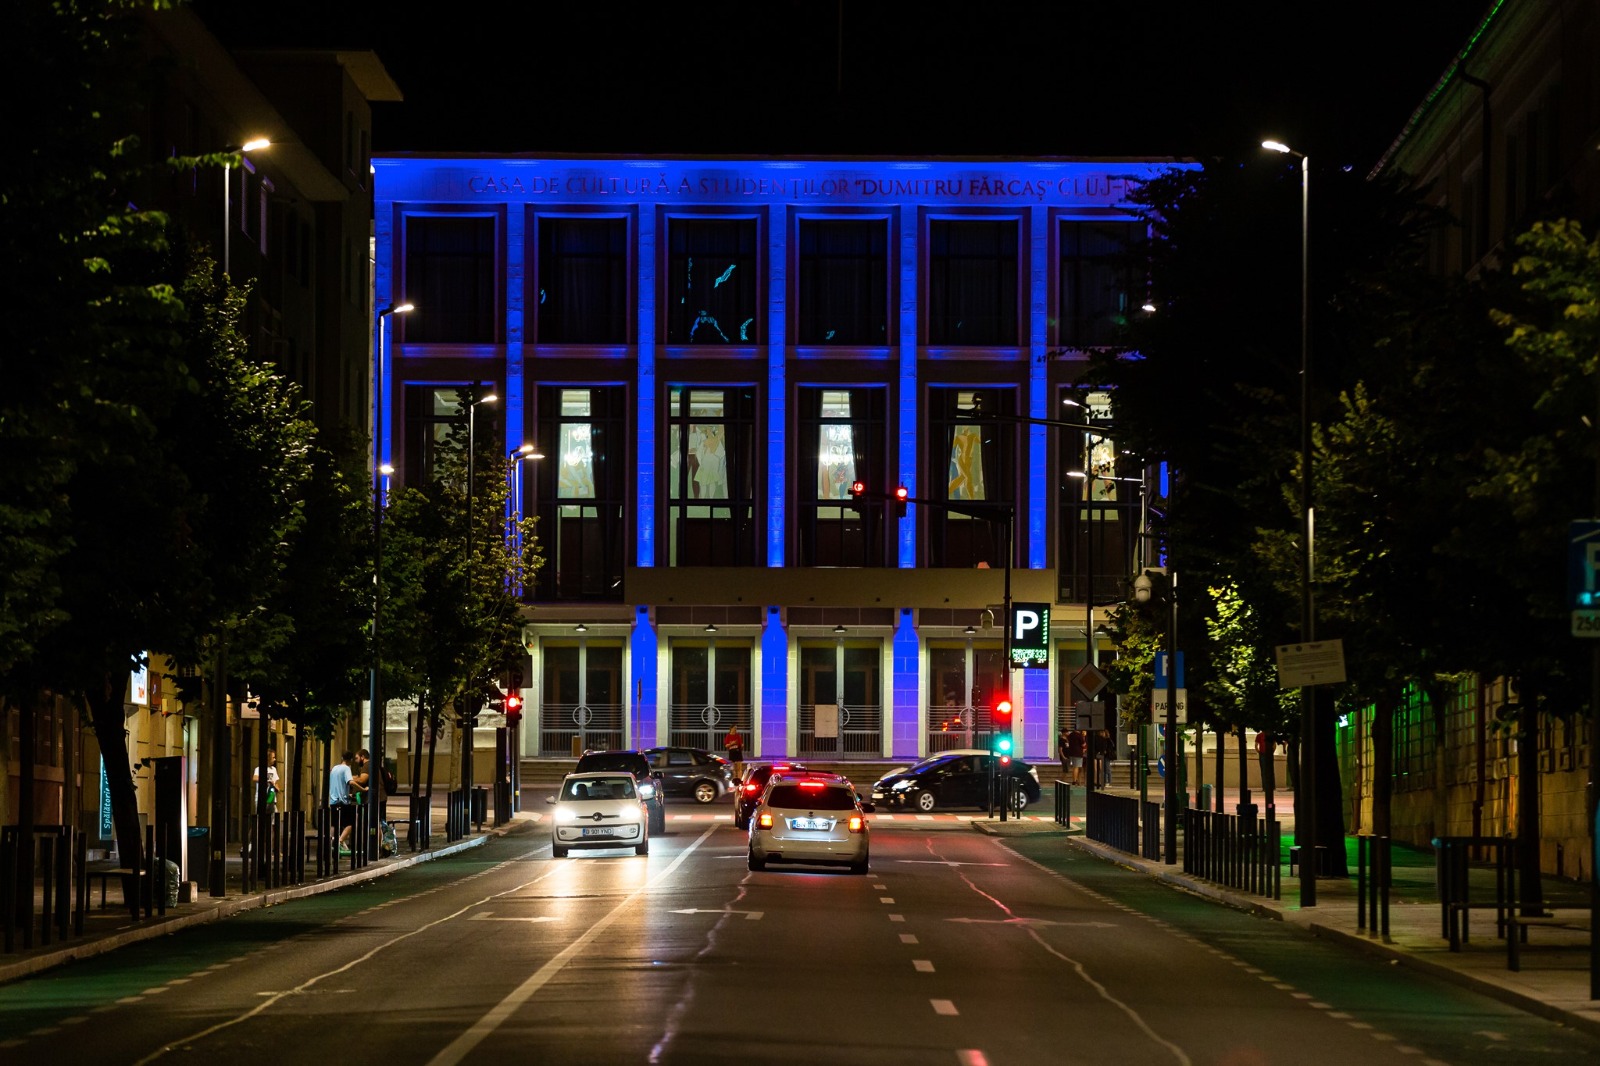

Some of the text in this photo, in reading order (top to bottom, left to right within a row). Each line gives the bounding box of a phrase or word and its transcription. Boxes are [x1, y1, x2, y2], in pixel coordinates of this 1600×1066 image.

[468, 176, 526, 194] CASA
[532, 176, 559, 194] DE
[566, 173, 670, 194] CULTURĂ
[677, 178, 692, 194] A
[1015, 610, 1039, 640] P
[1155, 702, 1184, 710] PARNG
